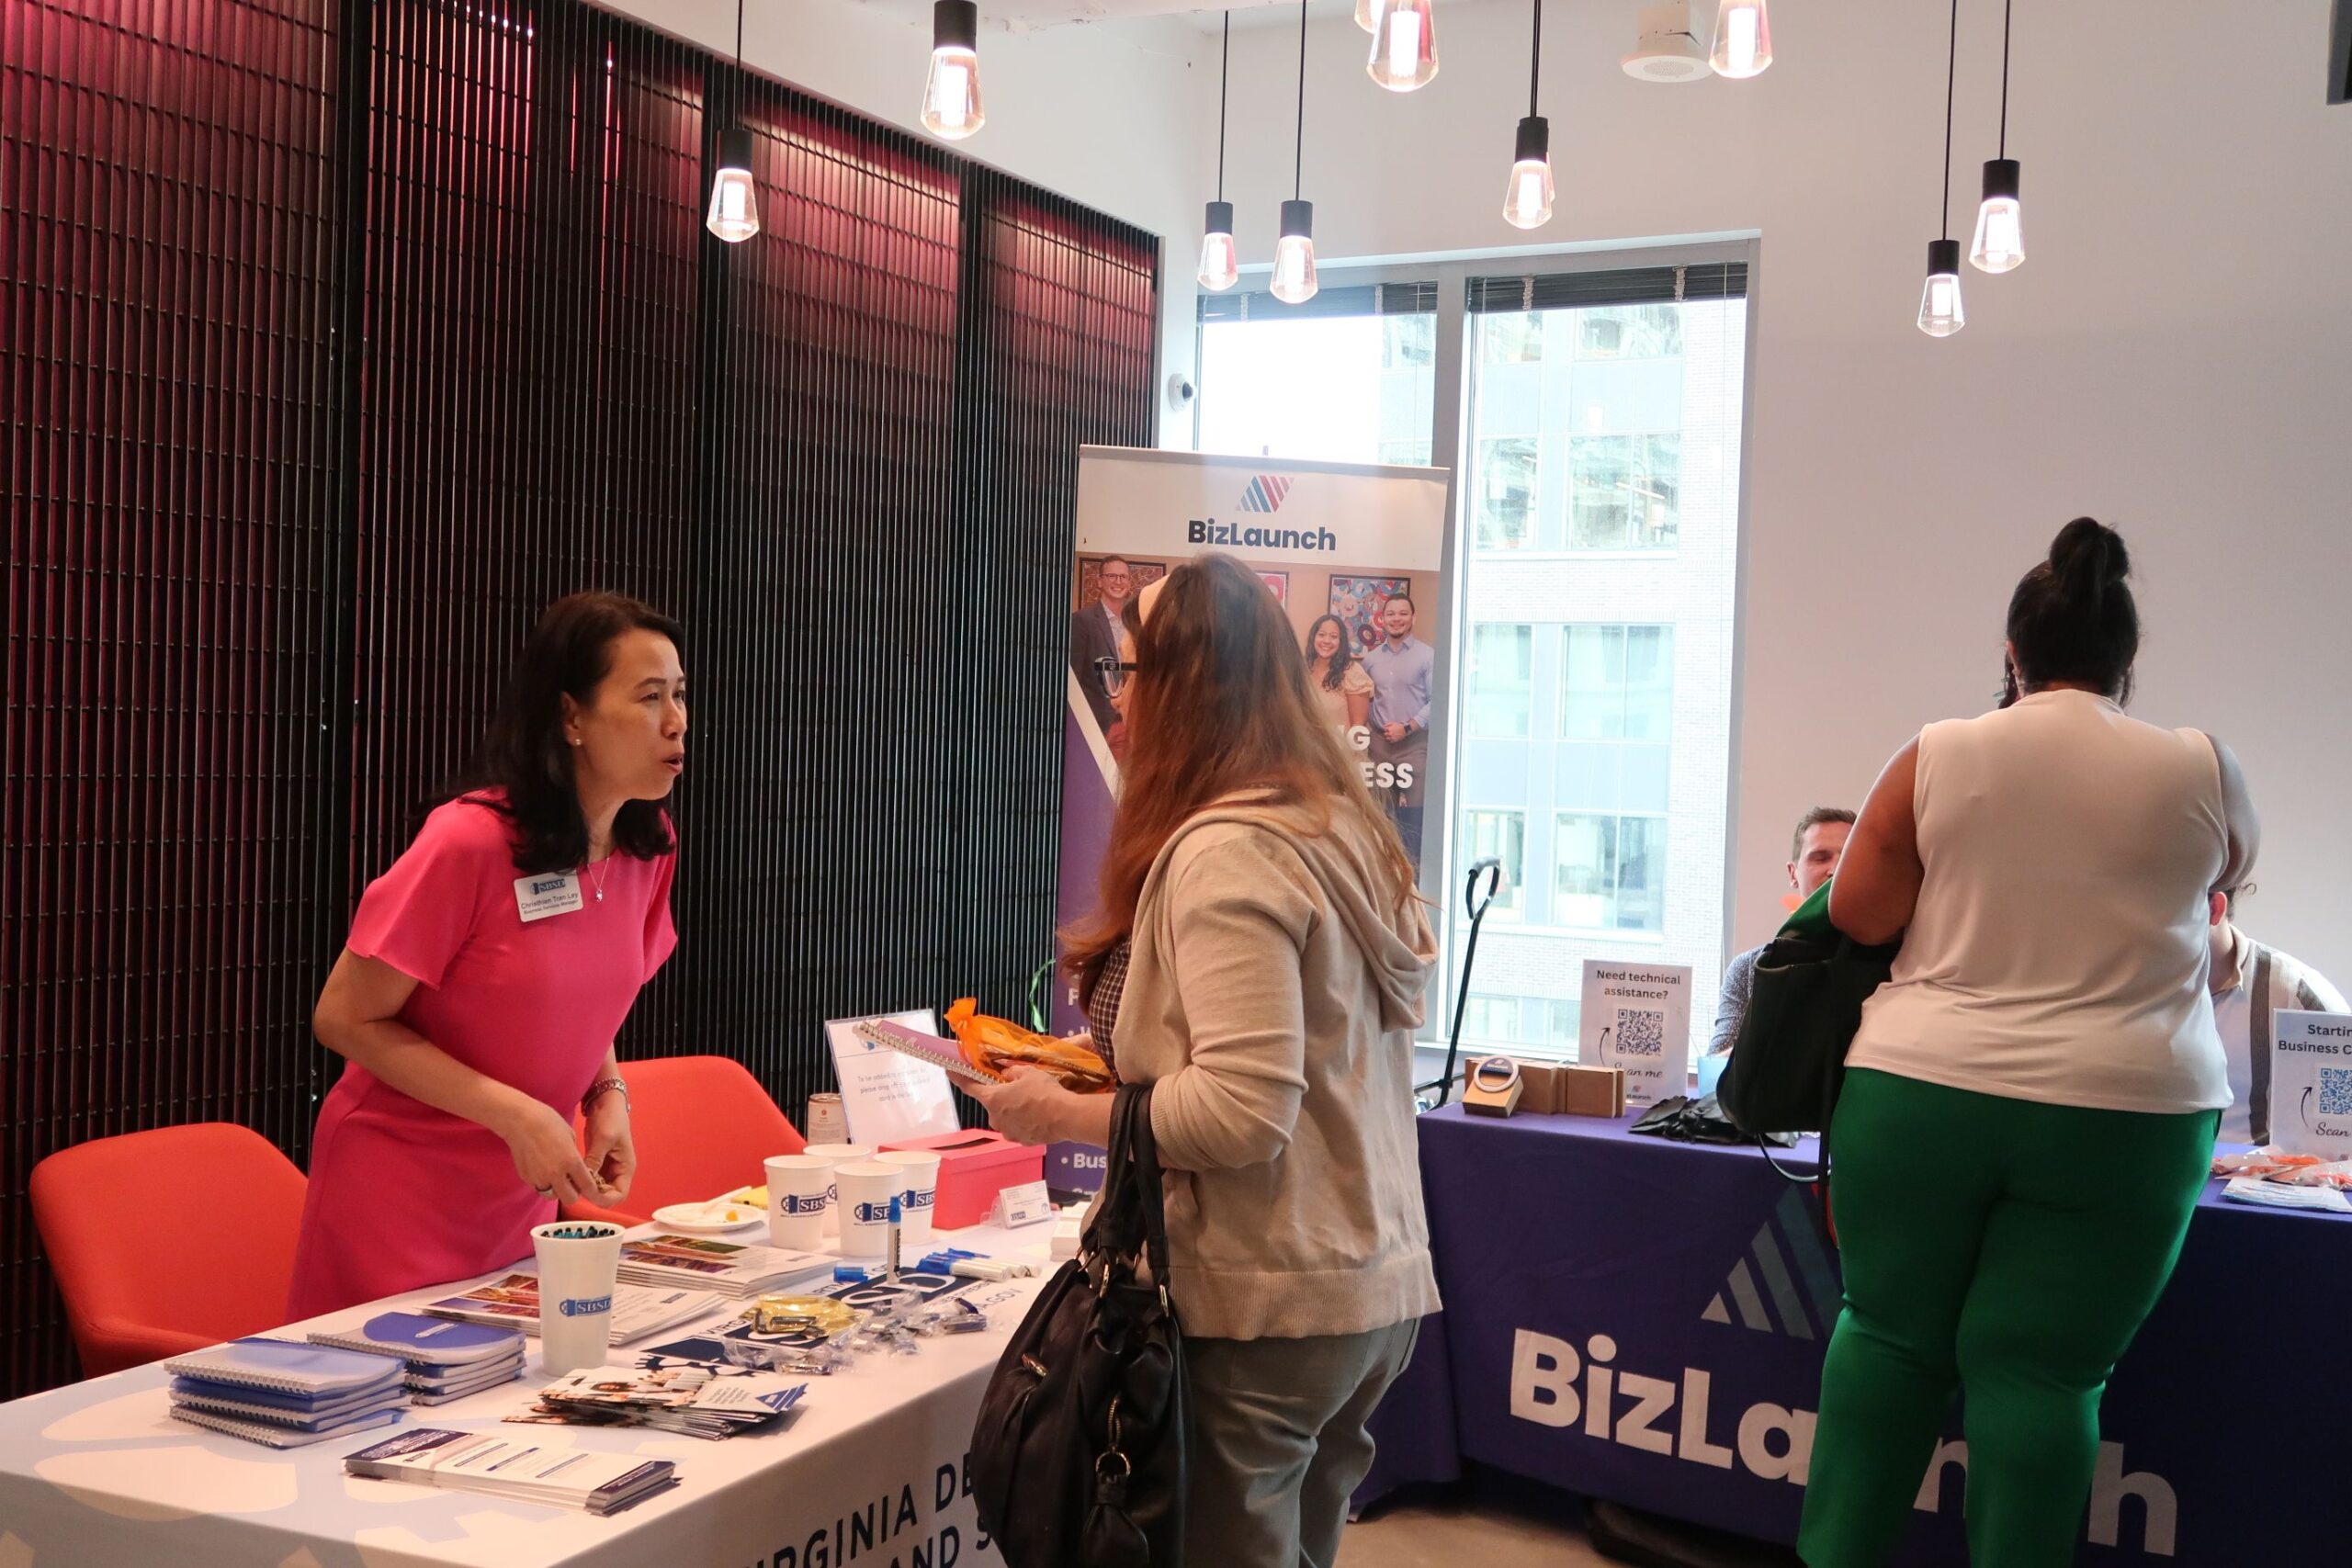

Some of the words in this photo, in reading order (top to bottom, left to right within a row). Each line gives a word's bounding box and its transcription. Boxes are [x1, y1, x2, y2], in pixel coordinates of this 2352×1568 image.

[1188, 518, 1336, 551] BizLaunch
[1596, 969, 1626, 981] Need
[1628, 972, 1681, 986] technical
[1603, 986, 1669, 1000] assistance?
[2278, 1040, 2339, 1055] Business
[1645, 1070, 1664, 1078] me
[2315, 1122, 2351, 1137] Scan
